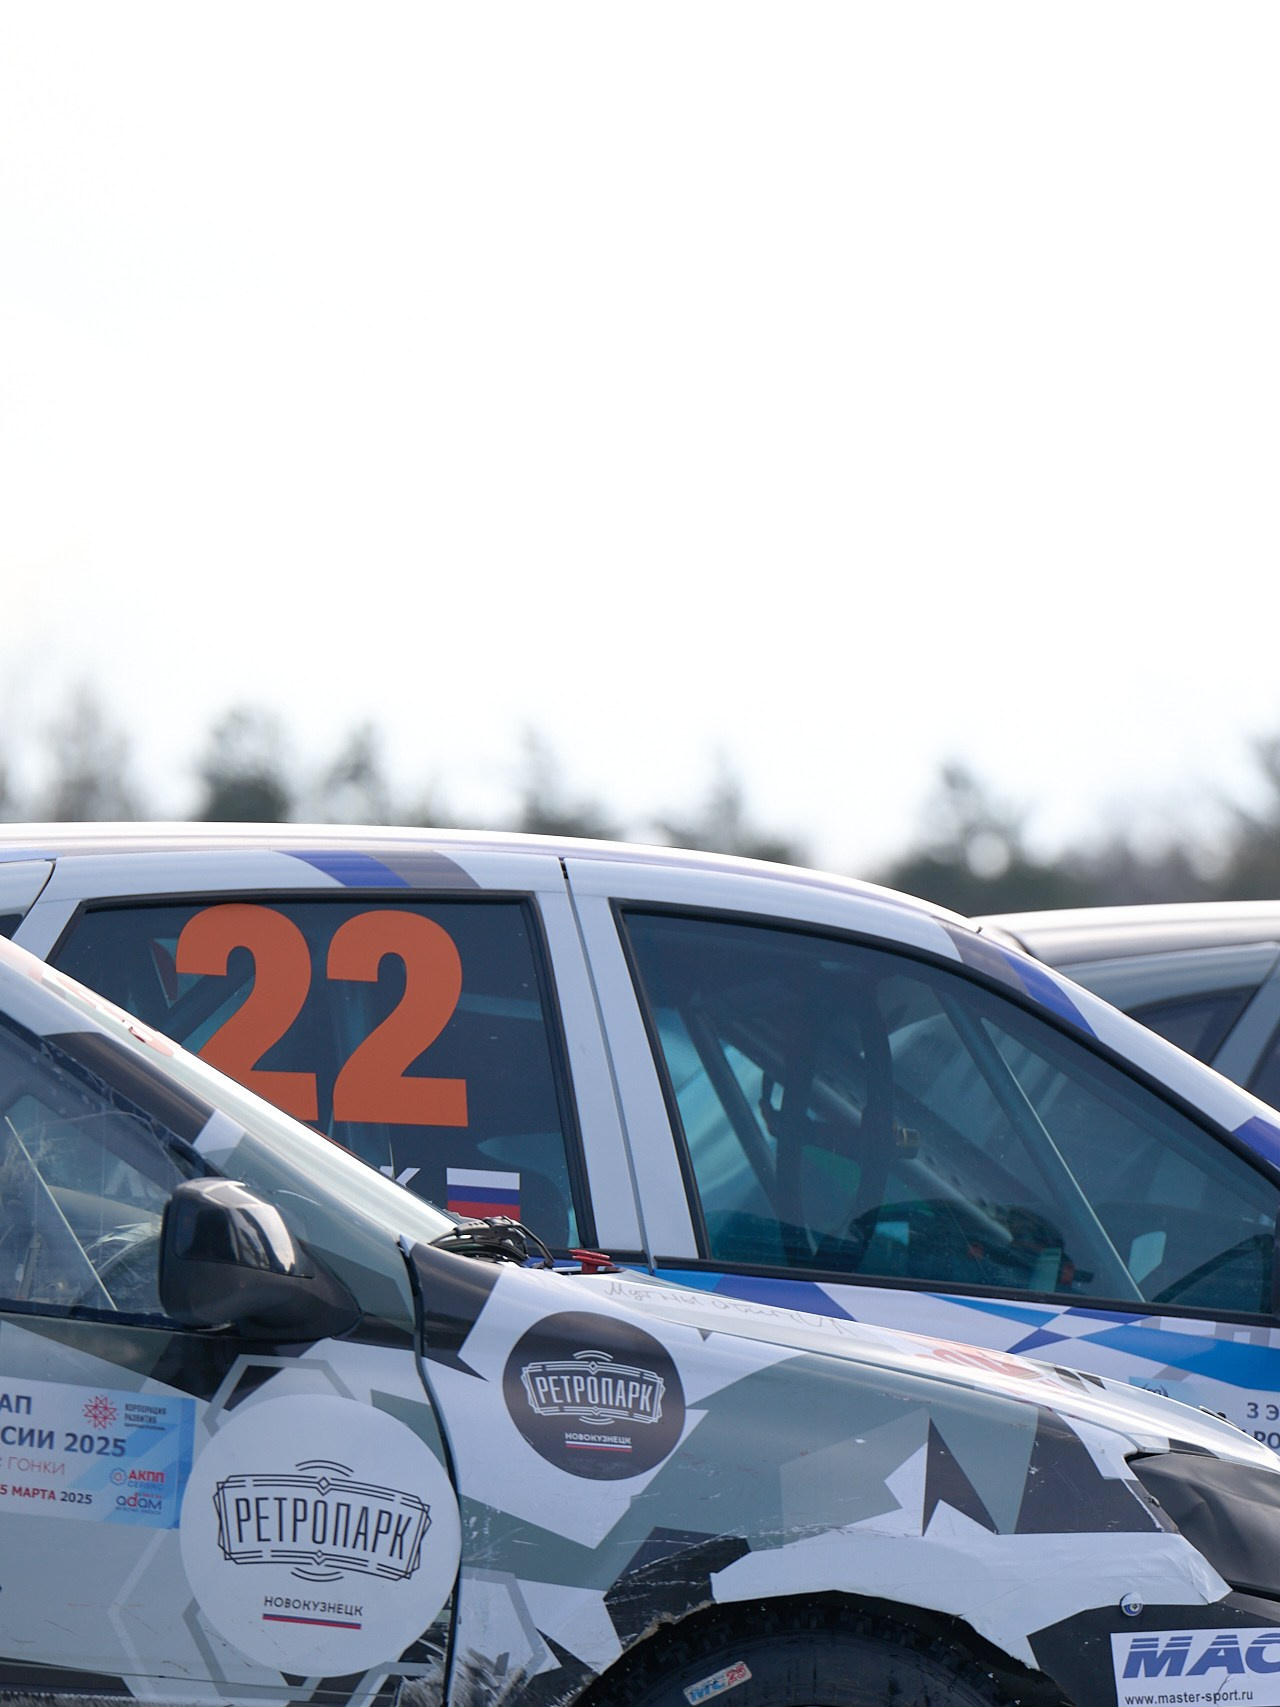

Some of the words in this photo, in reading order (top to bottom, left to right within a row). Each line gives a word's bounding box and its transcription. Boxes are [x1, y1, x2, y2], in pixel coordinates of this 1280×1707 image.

[175, 903, 468, 1127] 22
[535, 1375, 653, 1412] РЕТРОПАРК
[1247, 1402, 1258, 1419] 3
[64, 1432, 126, 1457] 2025
[565, 1432, 632, 1445] НОВОКУЗНЕЦК
[8, 1456, 65, 1475] ГОНКИ
[128, 1470, 164, 1483] АКПП
[12, 1486, 56, 1501] МАРТА
[60, 1491, 93, 1505] 2025
[235, 1497, 412, 1560] РЕТРОПАРК
[264, 1595, 363, 1616] НОВОКУЗНЕЦК
[1124, 1690, 1253, 1705] www.master-sport.ru
